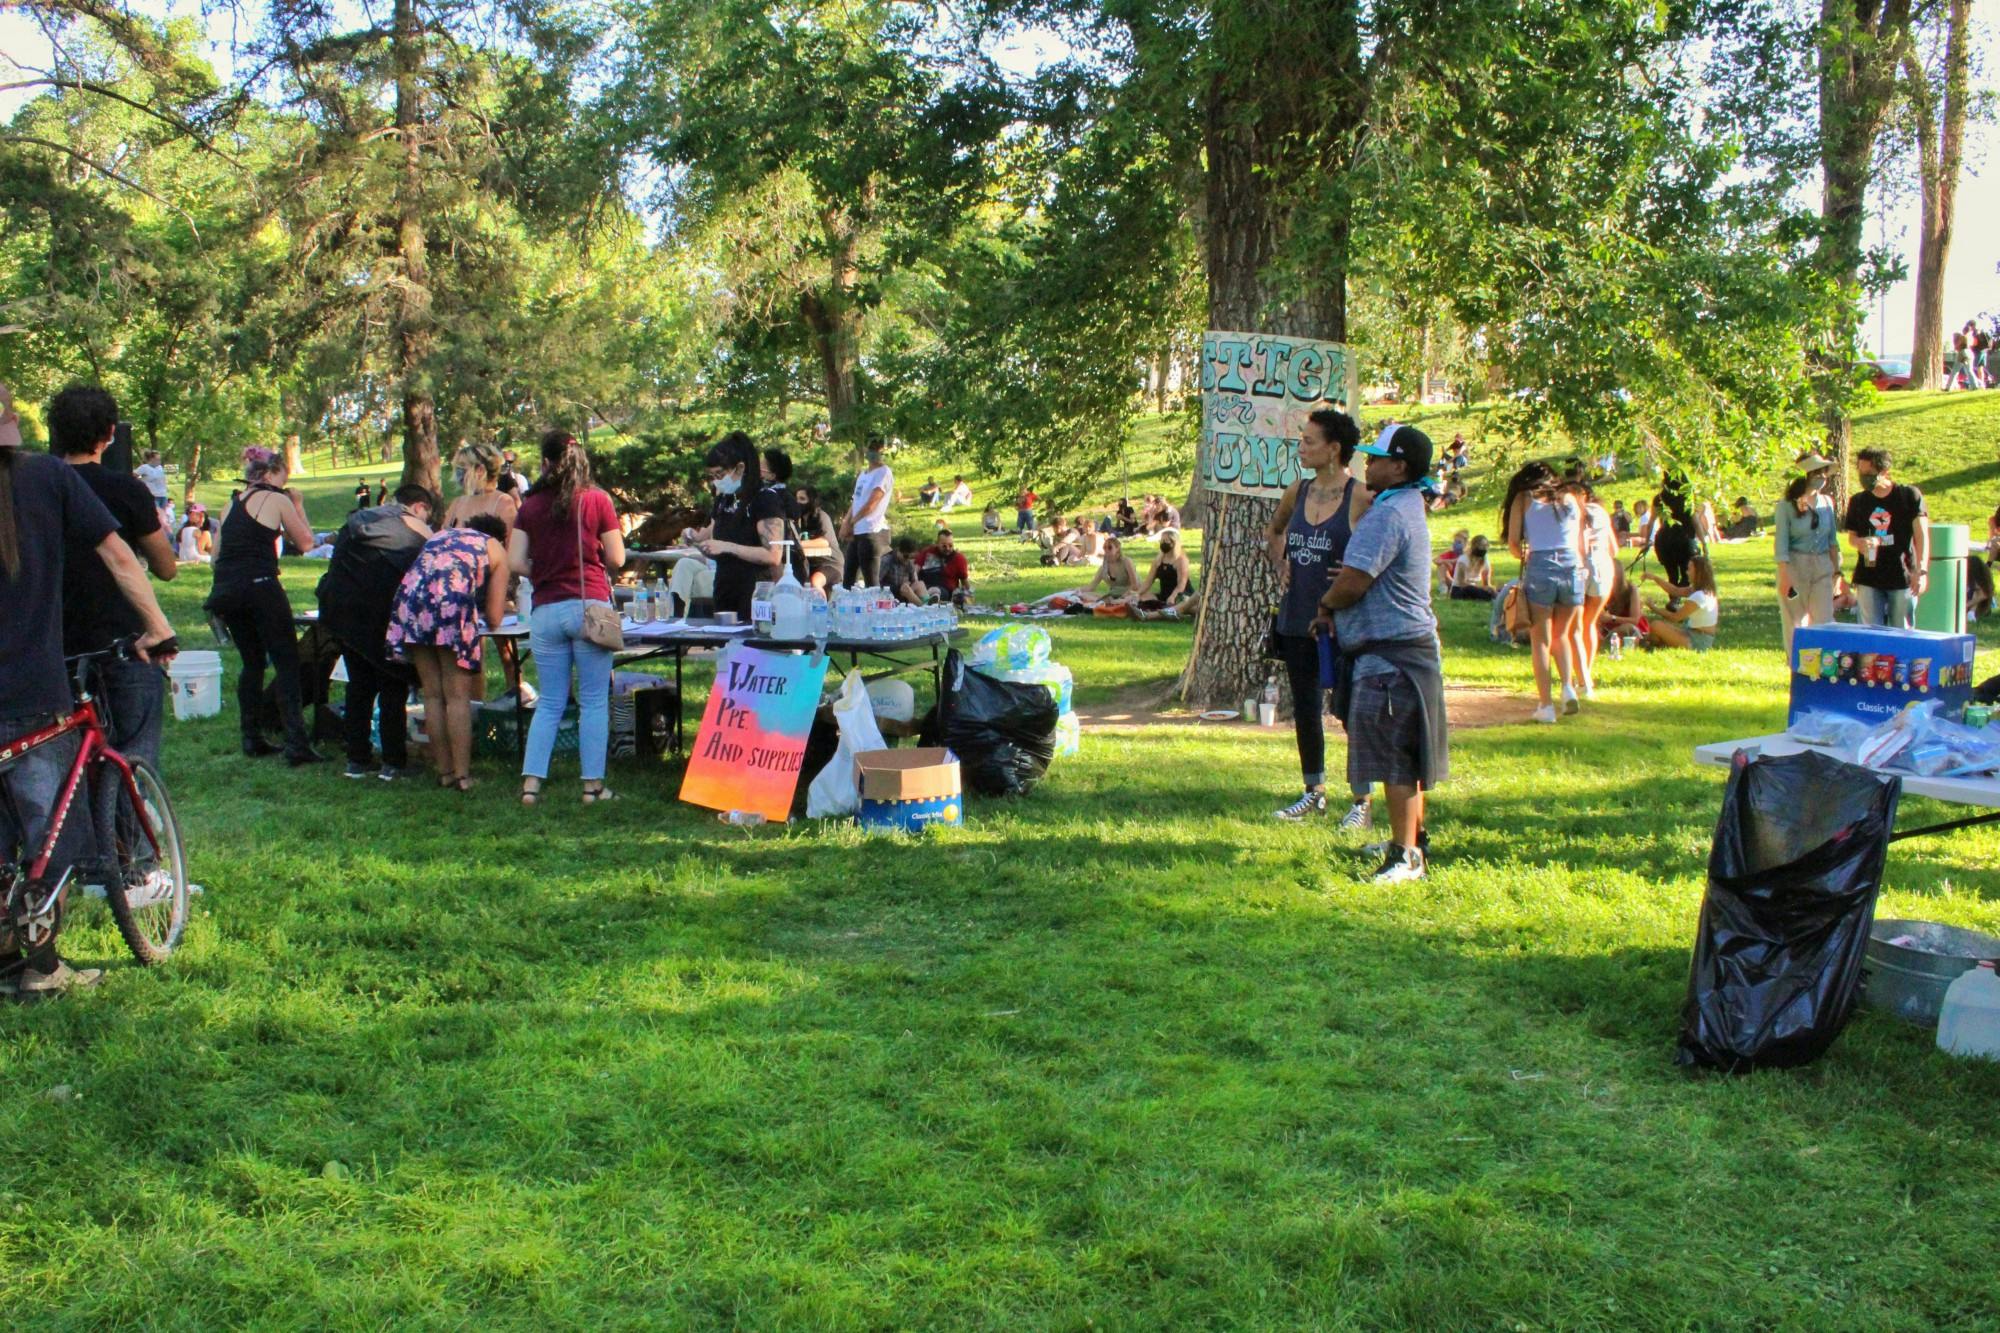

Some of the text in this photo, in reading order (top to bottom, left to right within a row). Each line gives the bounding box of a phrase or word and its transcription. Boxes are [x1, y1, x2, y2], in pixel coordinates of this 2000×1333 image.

[1288, 529, 1333, 551] enn state
[1856, 701, 1885, 713] Classic
[703, 731, 804, 772] AND SUPPLIES
